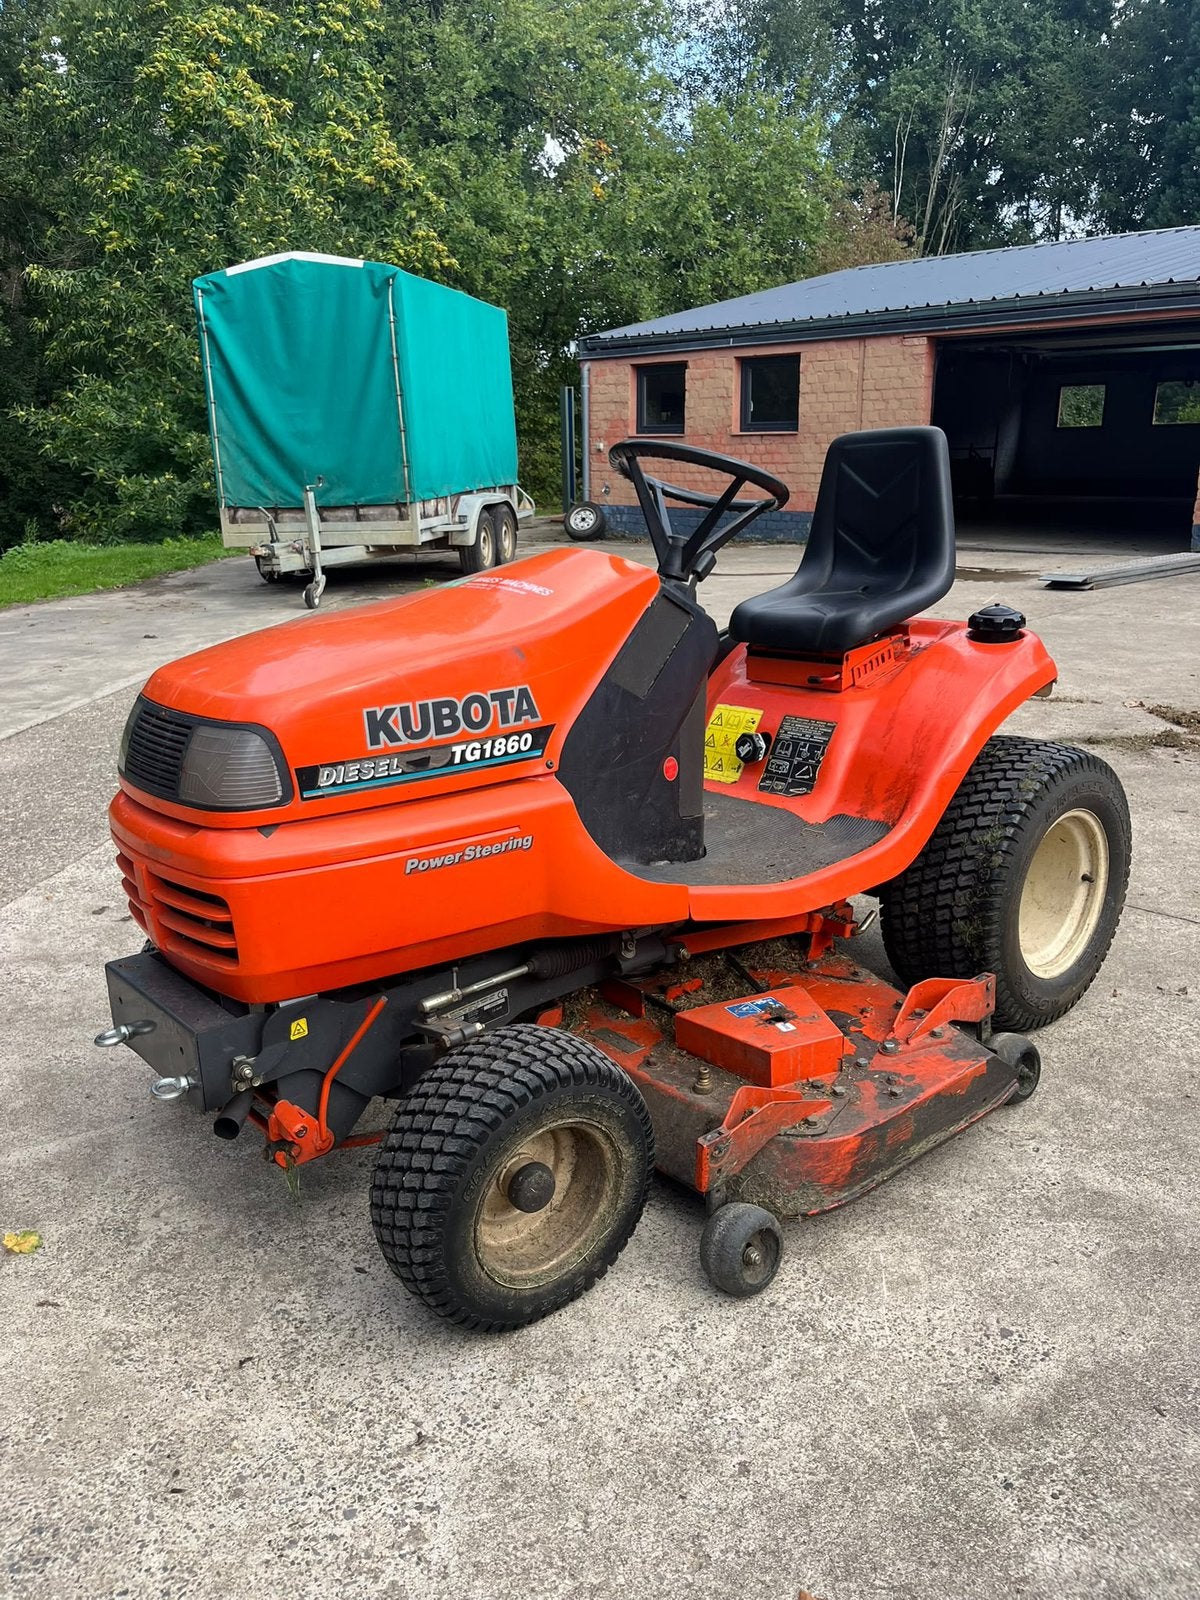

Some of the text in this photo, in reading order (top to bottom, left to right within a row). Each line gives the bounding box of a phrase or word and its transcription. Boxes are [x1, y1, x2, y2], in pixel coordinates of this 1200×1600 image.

[363, 684, 541, 750] KUBOTA
[319, 732, 533, 787] DIESEL TG1860
[405, 835, 534, 875] Power Steering
